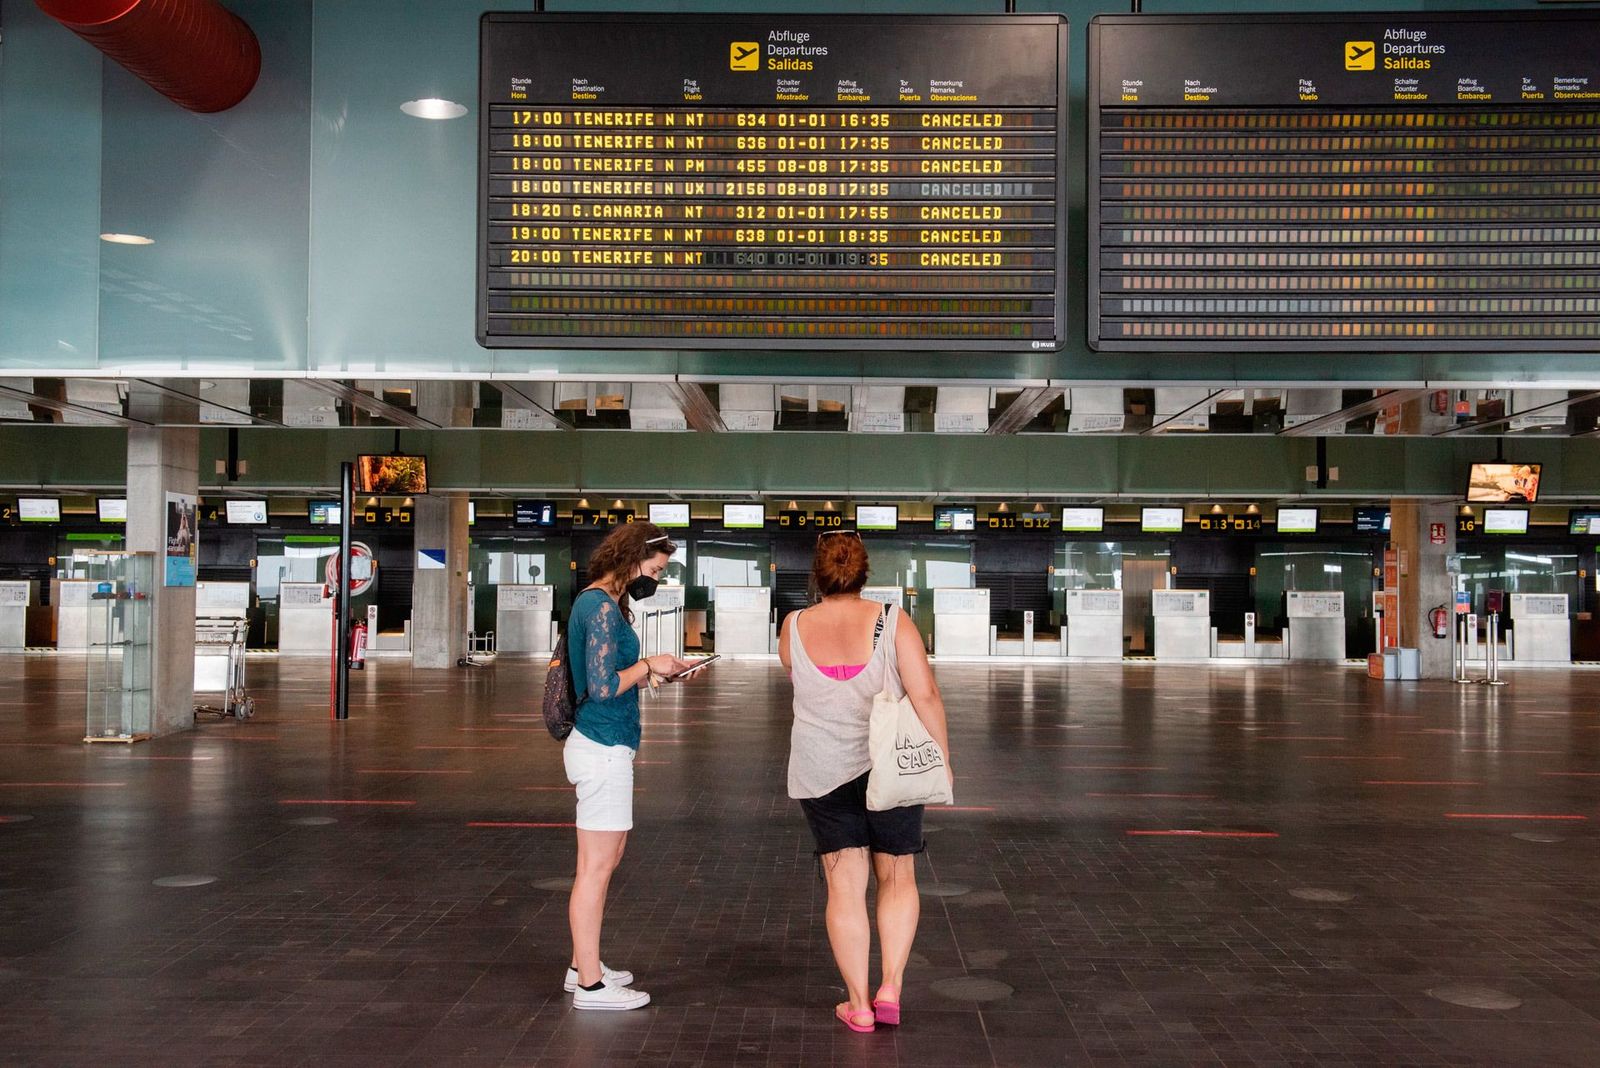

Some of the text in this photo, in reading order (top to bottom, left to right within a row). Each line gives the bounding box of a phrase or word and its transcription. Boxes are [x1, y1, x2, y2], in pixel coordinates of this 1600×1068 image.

[768, 31, 810, 42] Abfluge
[1384, 29, 1426, 41] Abfluge
[768, 44, 828, 57] Departures
[1383, 42, 1445, 56] Departures
[768, 58, 813, 70] Salidas
[1384, 57, 1430, 69] Salidas
[1299, 79, 1312, 87] Flug
[1458, 78, 1477, 86] Abflug
[1299, 86, 1316, 94] Flight
[1394, 85, 1418, 93] Counter
[1458, 85, 1484, 93] Boarding
[837, 94, 870, 102] Embarque
[1458, 93, 1491, 101] Embarque
[512, 112, 1003, 127] 17:00 TENERIFE N NT 634 01-01 16:35 CANCELED
[512, 135, 1003, 150] 18:00 TENERIFE N NT 636 01-01 17:35 CANCELED
[512, 158, 1003, 173] 18:00 TENERIFE N PM 455 08-08 17:35 CANCELED
[511, 181, 1003, 196] 18:00 TENERIFE N UX 2156 08-08 17:35 CANCELED
[511, 204, 1003, 219] 18:20 G.CANARIA NT 312 01-01 17:55 CANCELED
[511, 227, 1002, 242] 19:00 TENERIFE N NT 638 01-01 18:35 CANCELED
[510, 250, 1002, 265] 20:00 TENERIFE N NT 640 01-01 19:35 CANCELED
[3, 508, 10, 518] 2
[209, 511, 217, 520] 4
[385, 512, 392, 522] 5
[592, 515, 599, 525] 7
[626, 514, 634, 524] 8
[798, 516, 806, 526] 9
[827, 516, 841, 526] 10
[1002, 518, 1014, 528] 11
[1036, 518, 1050, 528] 12
[1214, 520, 1227, 529] 13
[1246, 520, 1260, 529] 14
[1460, 521, 1474, 531] 16
[896, 733, 915, 750] LA
